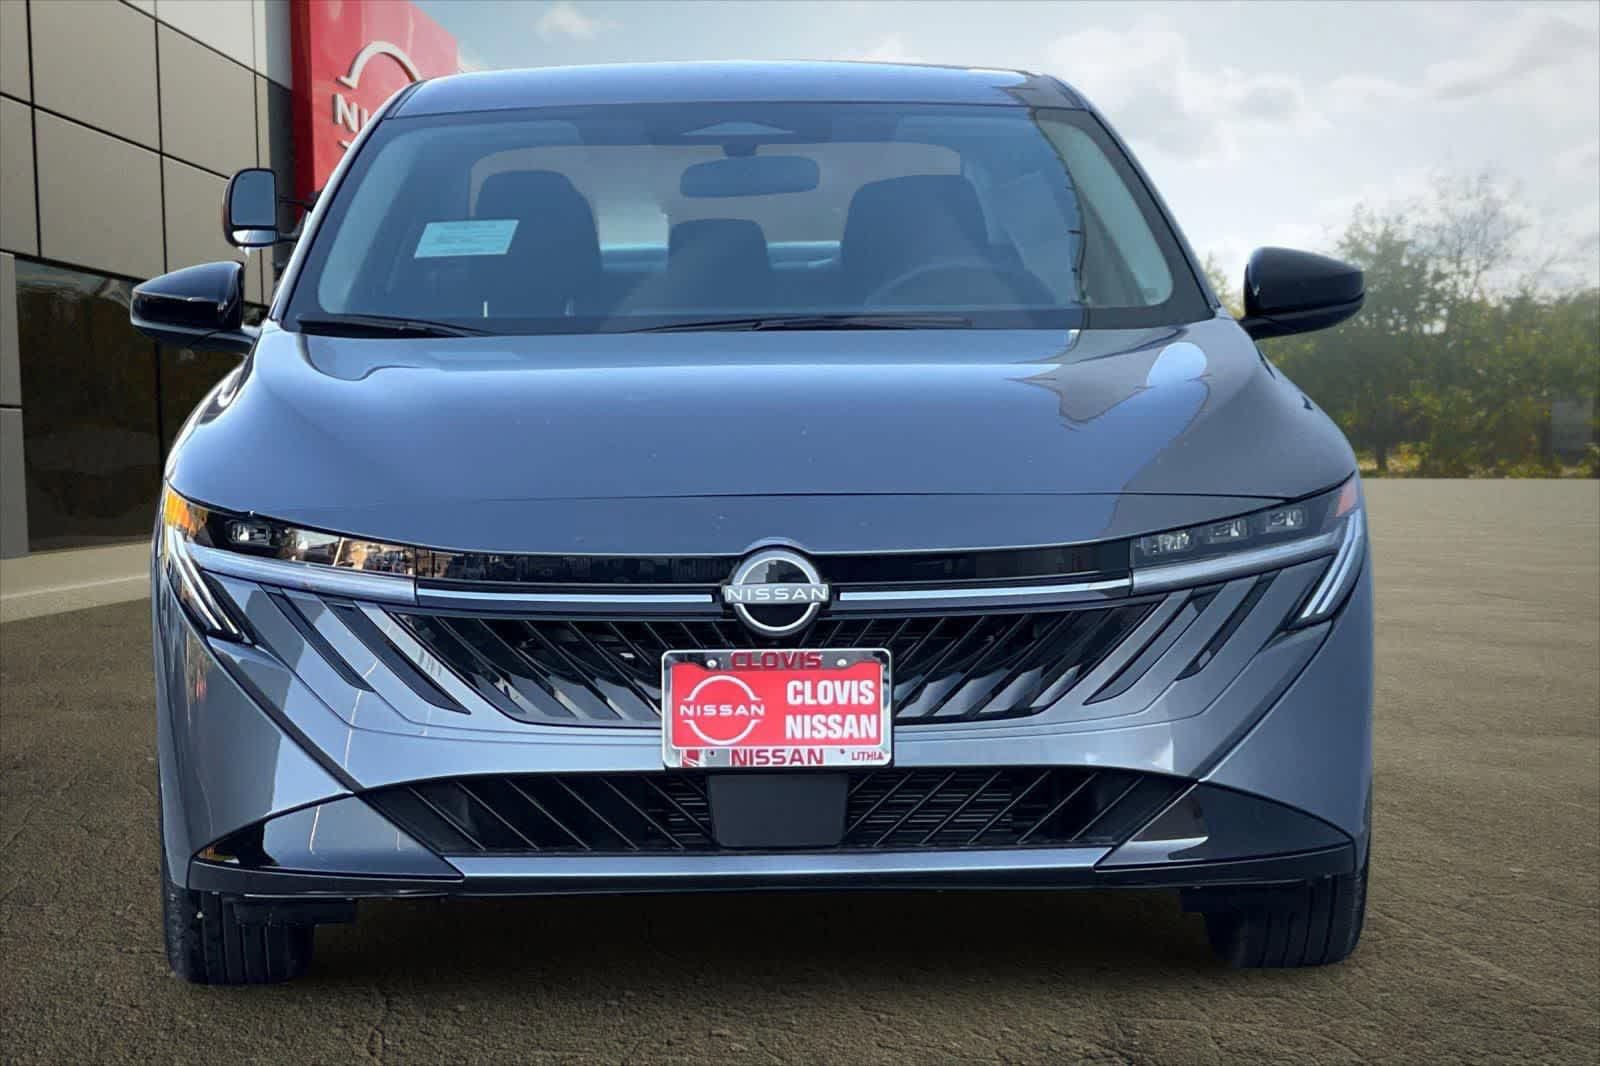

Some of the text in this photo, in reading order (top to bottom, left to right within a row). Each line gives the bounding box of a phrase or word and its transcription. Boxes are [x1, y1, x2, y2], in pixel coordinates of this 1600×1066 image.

[726, 586, 827, 601] NISSAN
[730, 652, 822, 670] CLOVIS
[786, 680, 875, 705] CLOVIS
[680, 704, 765, 717] NISSAN
[785, 714, 877, 740] NISSAN
[730, 749, 824, 766] NISSAN
[851, 751, 884, 761] LITHIA
